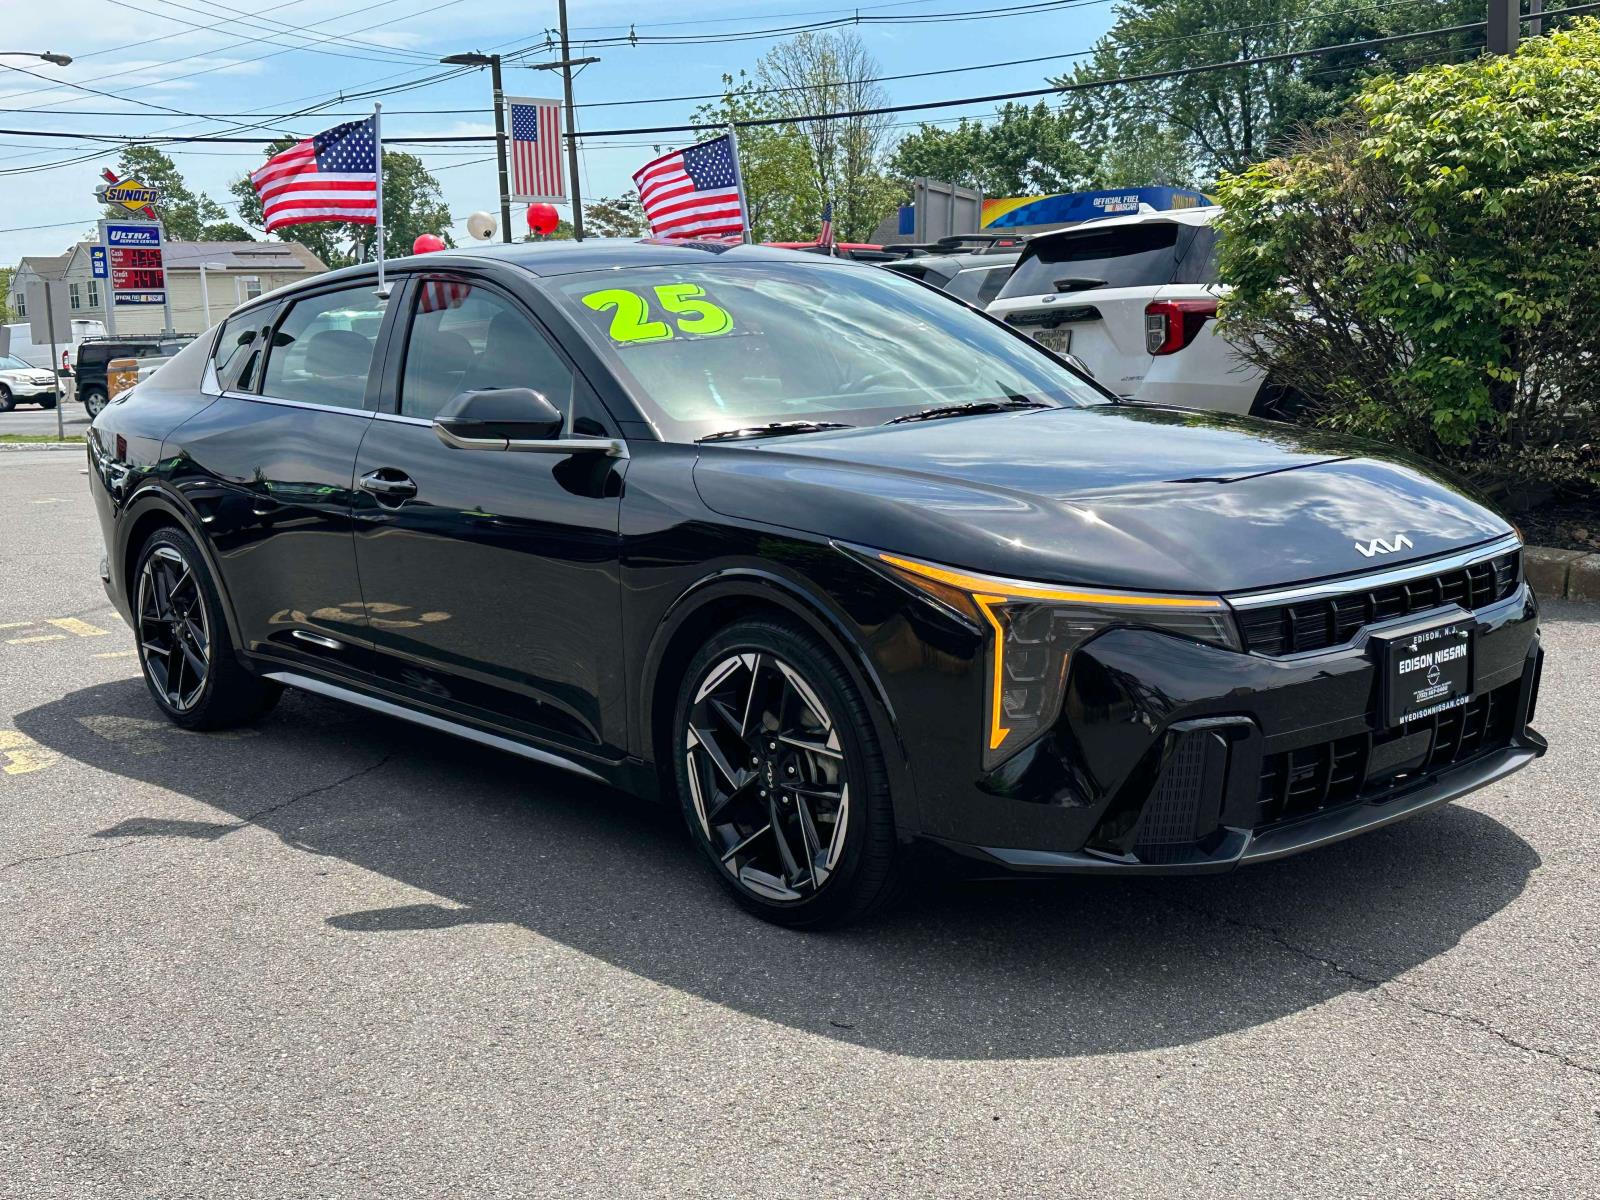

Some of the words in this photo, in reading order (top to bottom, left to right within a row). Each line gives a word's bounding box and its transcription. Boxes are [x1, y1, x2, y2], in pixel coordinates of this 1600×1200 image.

[107, 188, 158, 203] SUNOCO
[1093, 197, 1121, 206] OFFICIAL
[1123, 195, 1139, 203] FUEL
[1114, 202, 1137, 211] NASCAR
[111, 230, 150, 240] ULTRA
[113, 270, 128, 278] Credit
[582, 283, 734, 342] 25
[1413, 629, 1442, 645] EDISON,
[1444, 626, 1458, 636] N.J.
[1399, 653, 1433, 675] EDISON
[1434, 643, 1467, 665] NISSAN
[1399, 695, 1470, 725] MYEDISONNISSAN.COM
